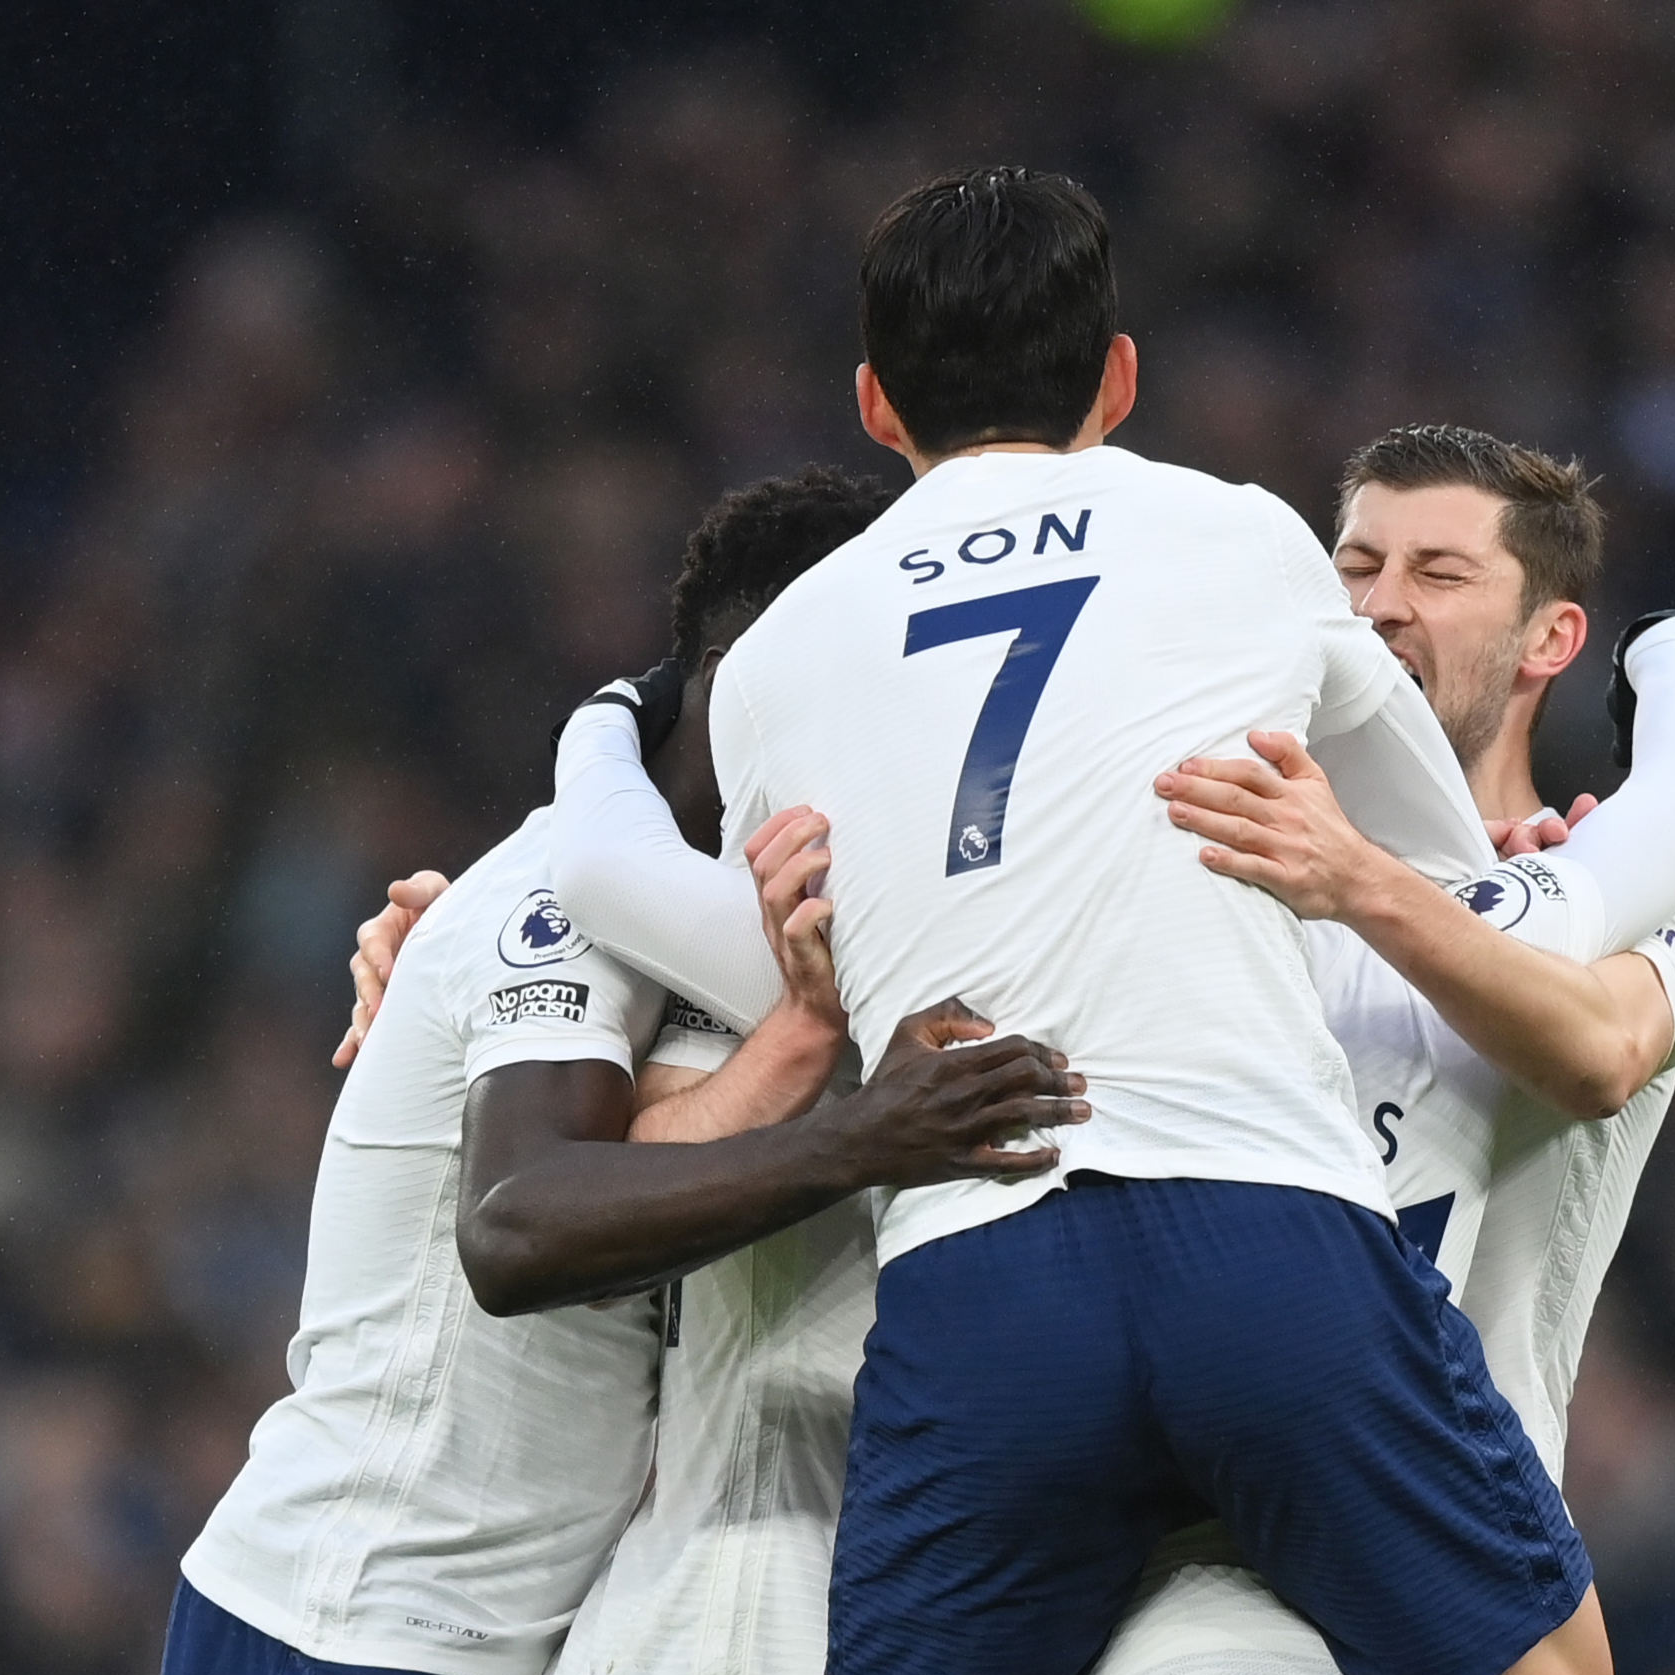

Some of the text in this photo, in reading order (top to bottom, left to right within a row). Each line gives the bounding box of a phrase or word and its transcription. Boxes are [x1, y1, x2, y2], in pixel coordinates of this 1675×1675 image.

[899, 509, 1093, 584] SON
[902, 574, 1102, 878] 7
[491, 983, 578, 1012] No room
[516, 998, 586, 1024] racism
